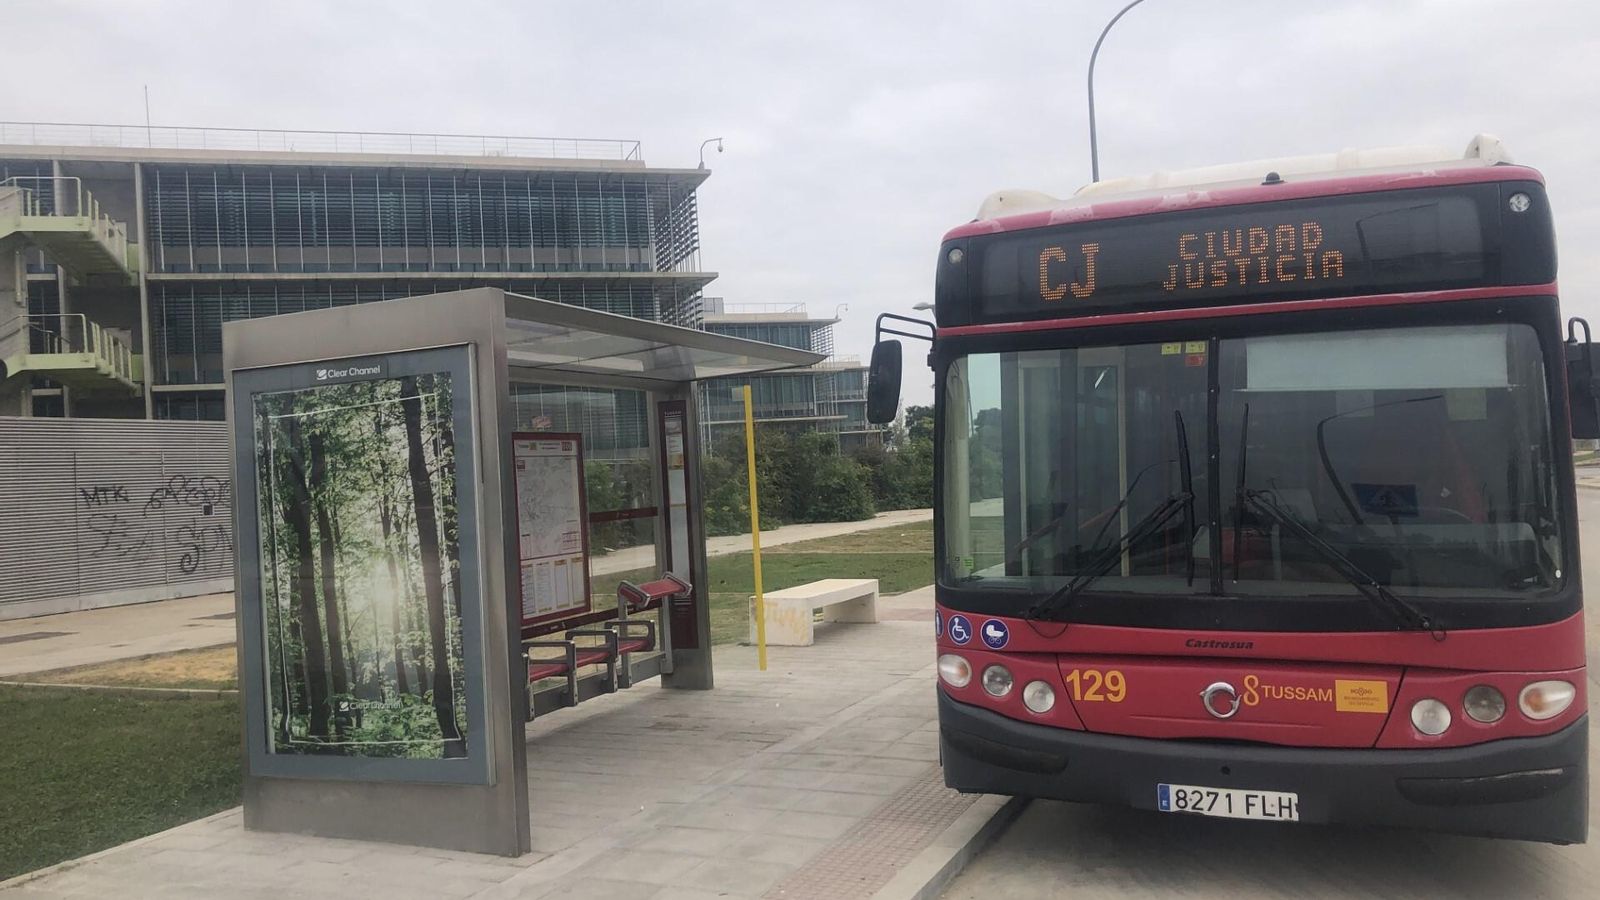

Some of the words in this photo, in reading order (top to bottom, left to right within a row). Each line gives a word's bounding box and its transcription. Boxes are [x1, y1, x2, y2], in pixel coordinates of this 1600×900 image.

[1180, 221, 1323, 260] CIUDAD
[1039, 243, 1099, 300] CJ
[1163, 250, 1343, 291] JUSTICIA
[327, 369, 348, 378] Clear
[349, 365, 381, 376] Channel
[1184, 638, 1255, 650] Castrosua
[1066, 669, 1127, 703] 129
[1260, 685, 1333, 702] TUSSAM
[1174, 788, 1233, 814] 8271
[1245, 793, 1293, 819] FLH
